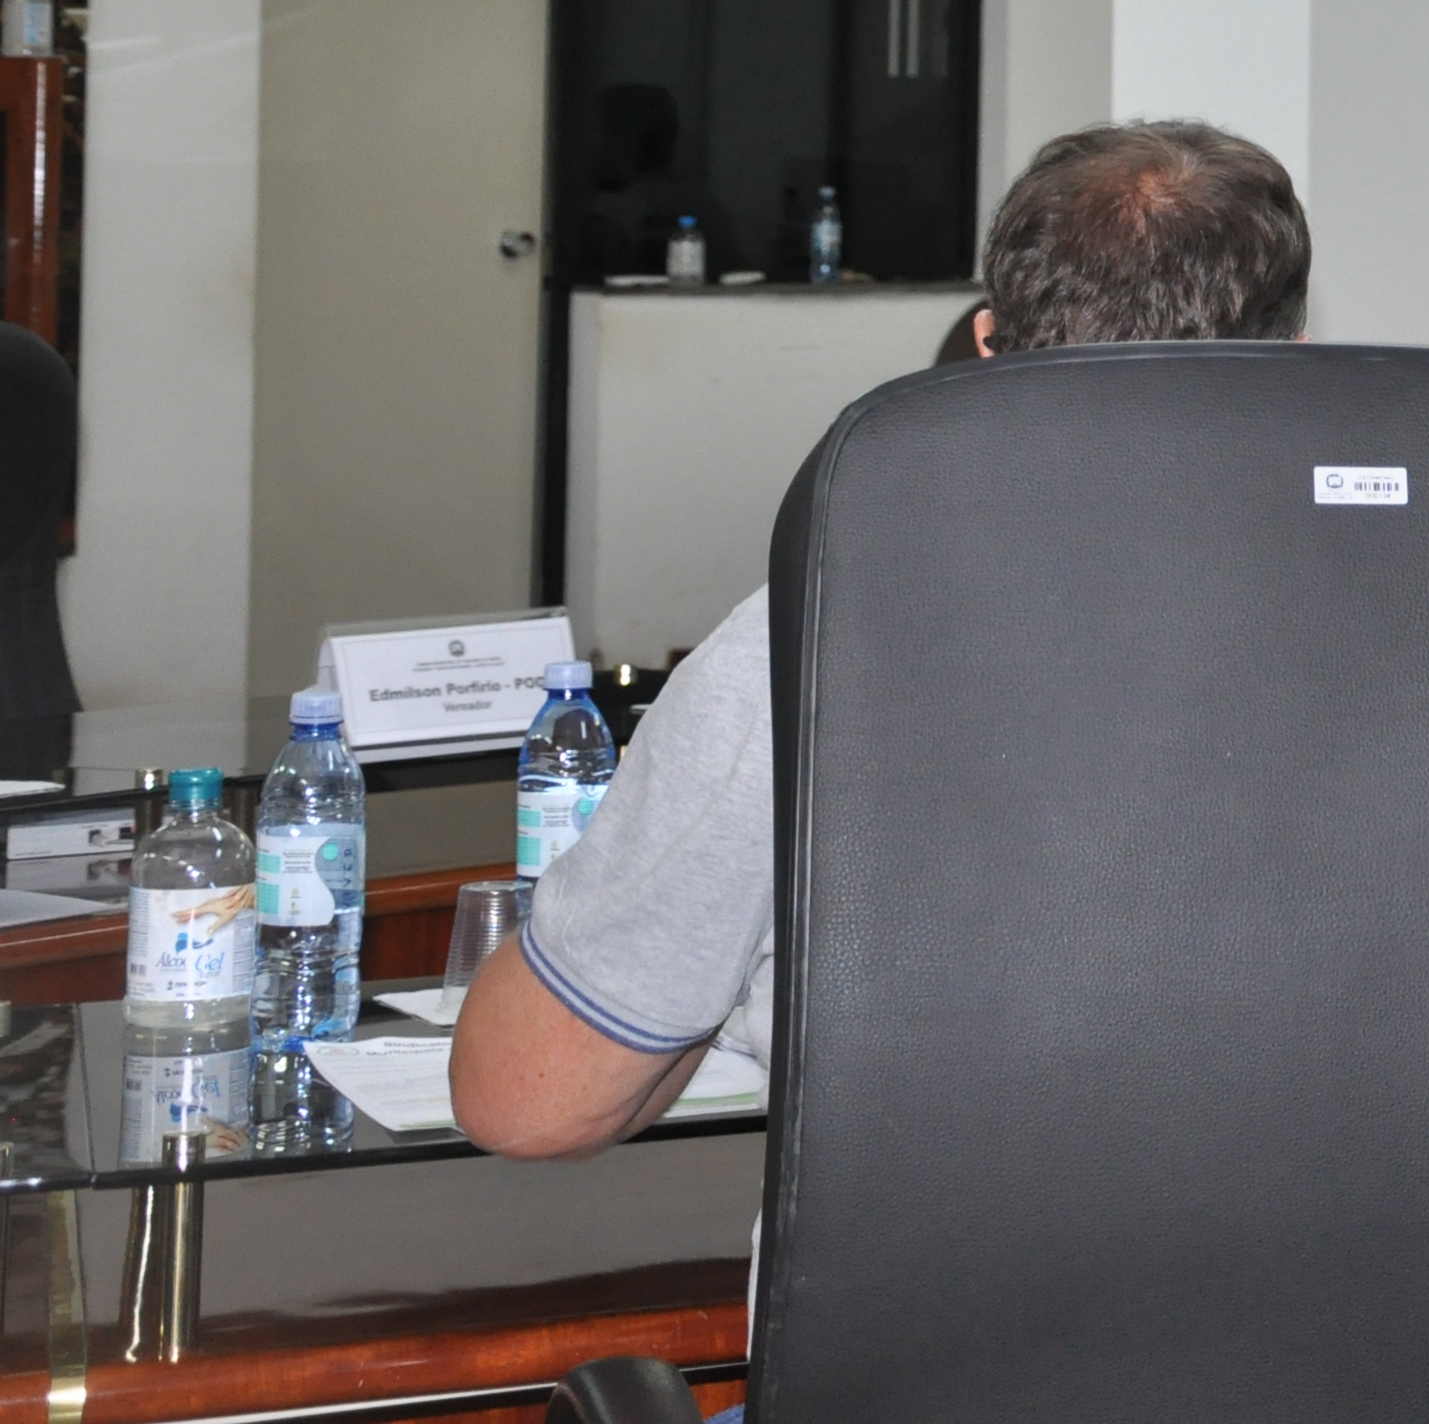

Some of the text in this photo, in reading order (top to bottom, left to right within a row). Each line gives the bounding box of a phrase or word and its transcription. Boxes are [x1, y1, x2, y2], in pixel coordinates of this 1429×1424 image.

[369, 687, 441, 701] Edmilson
[514, 676, 545, 689] POD
[443, 700, 492, 712] Vereador
